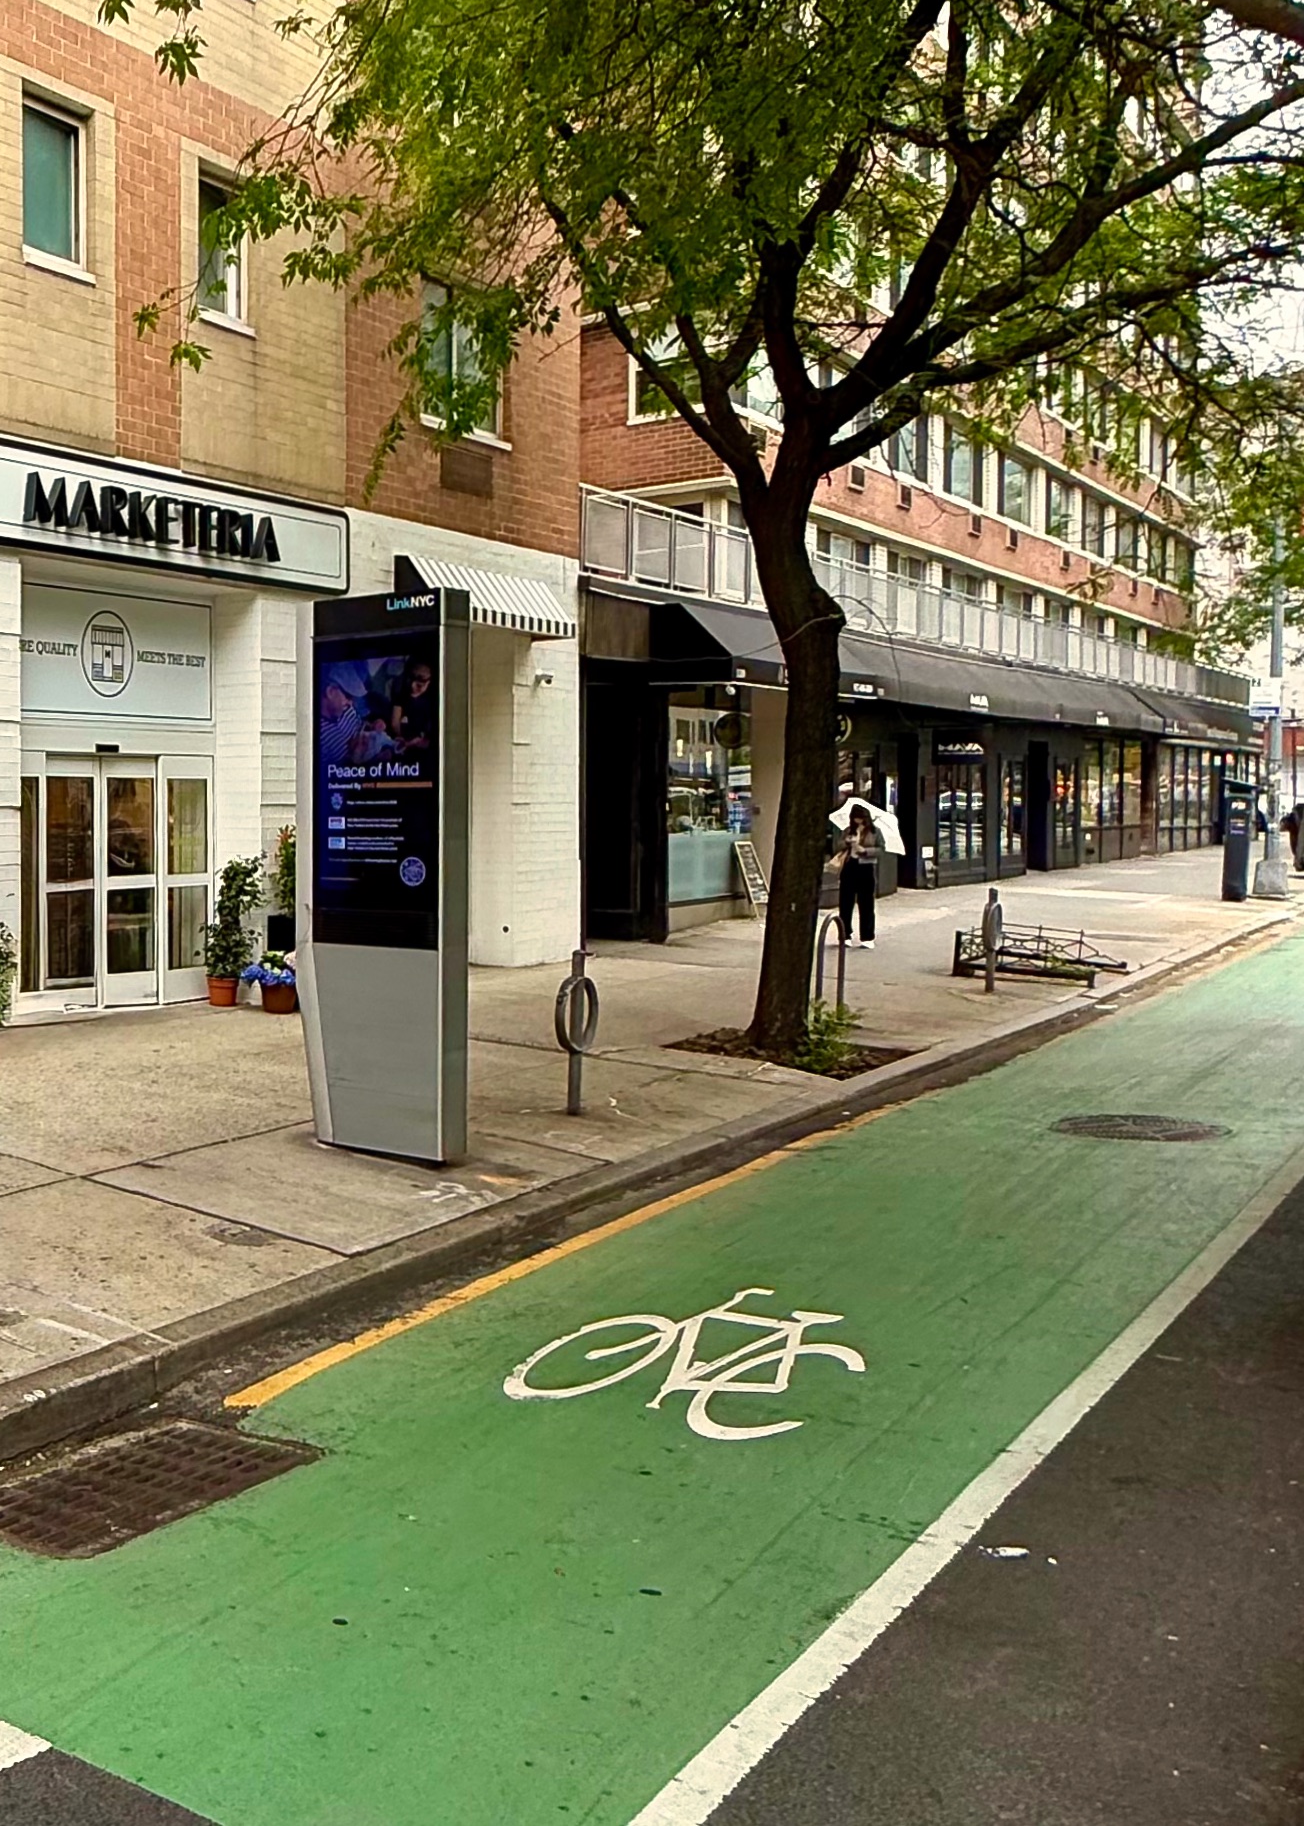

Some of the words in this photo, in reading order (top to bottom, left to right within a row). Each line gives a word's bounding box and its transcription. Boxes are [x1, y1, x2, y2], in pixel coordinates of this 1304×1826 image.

[23, 471, 281, 563] MARKETERIA
[386, 594, 435, 611] LinkNYC
[36, 640, 79, 657] QUALITY
[137, 650, 166, 664] MEETS
[167, 653, 185, 665] THE
[186, 654, 206, 668] BEST
[328, 764, 366, 778] Peace
[369, 762, 383, 777] of
[386, 761, 420, 777] Mind
